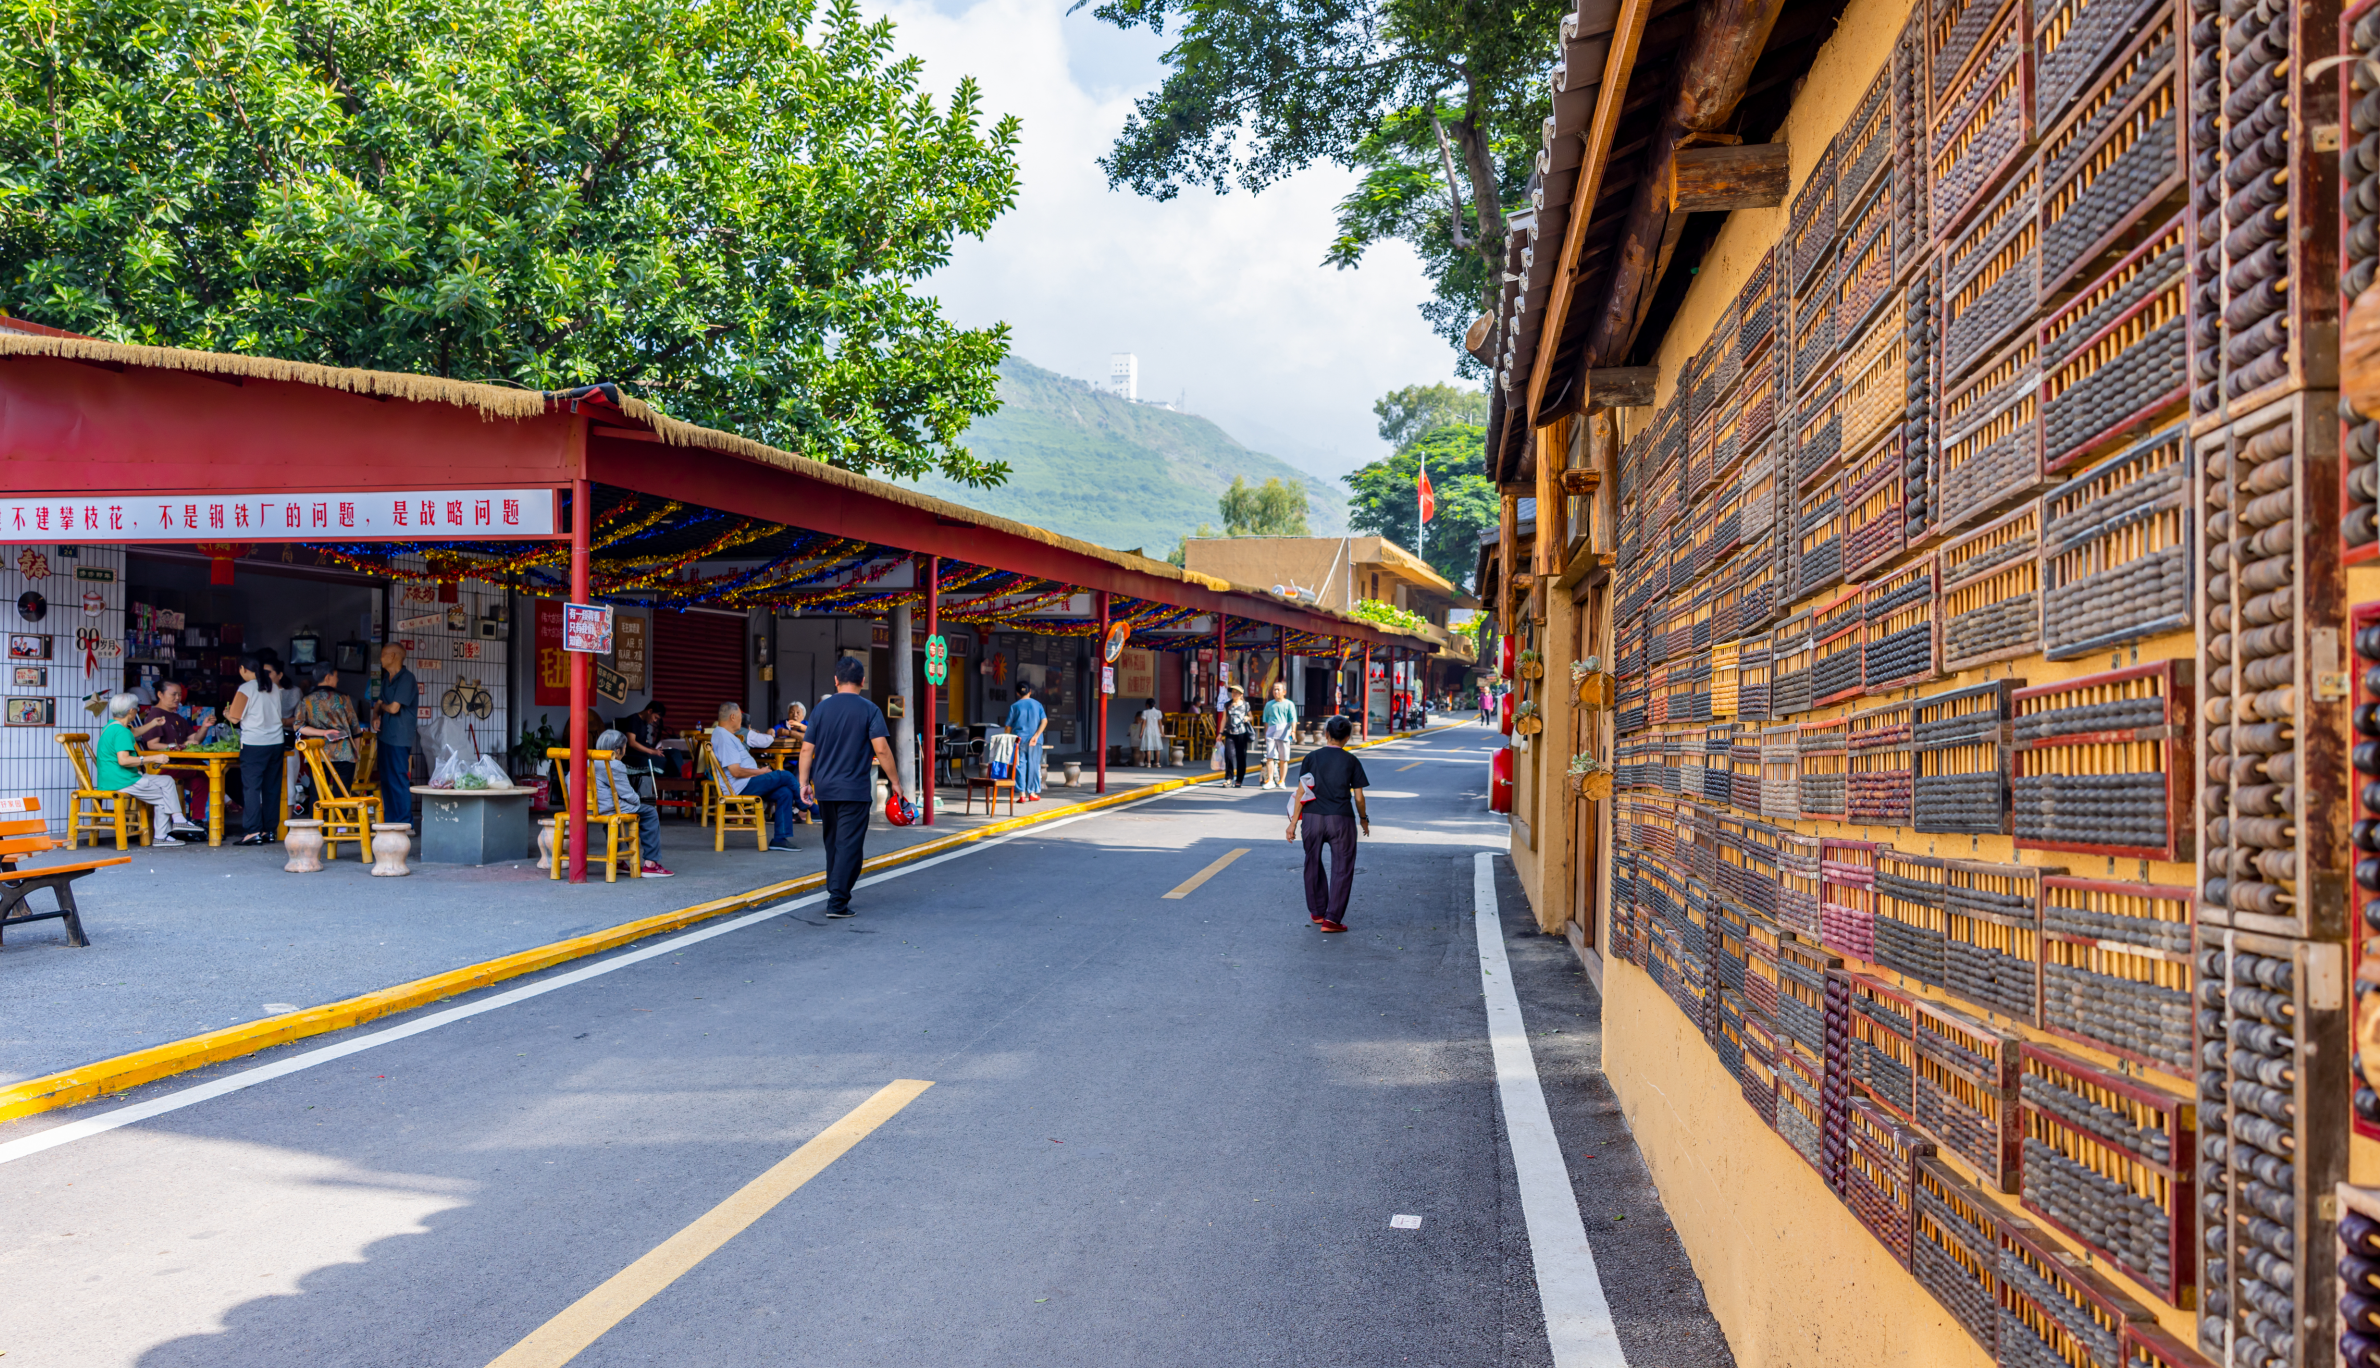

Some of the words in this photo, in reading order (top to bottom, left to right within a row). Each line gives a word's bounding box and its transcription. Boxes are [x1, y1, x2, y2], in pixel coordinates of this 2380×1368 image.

[0, 499, 519, 531] 不建攀枝花，不是钢铁厂的问题，是战略问题
[19, 549, 50, 579] 青春
[76, 627, 100, 651] 80
[569, 621, 594, 635] 只有我们
[100, 639, 115, 651] 岁月
